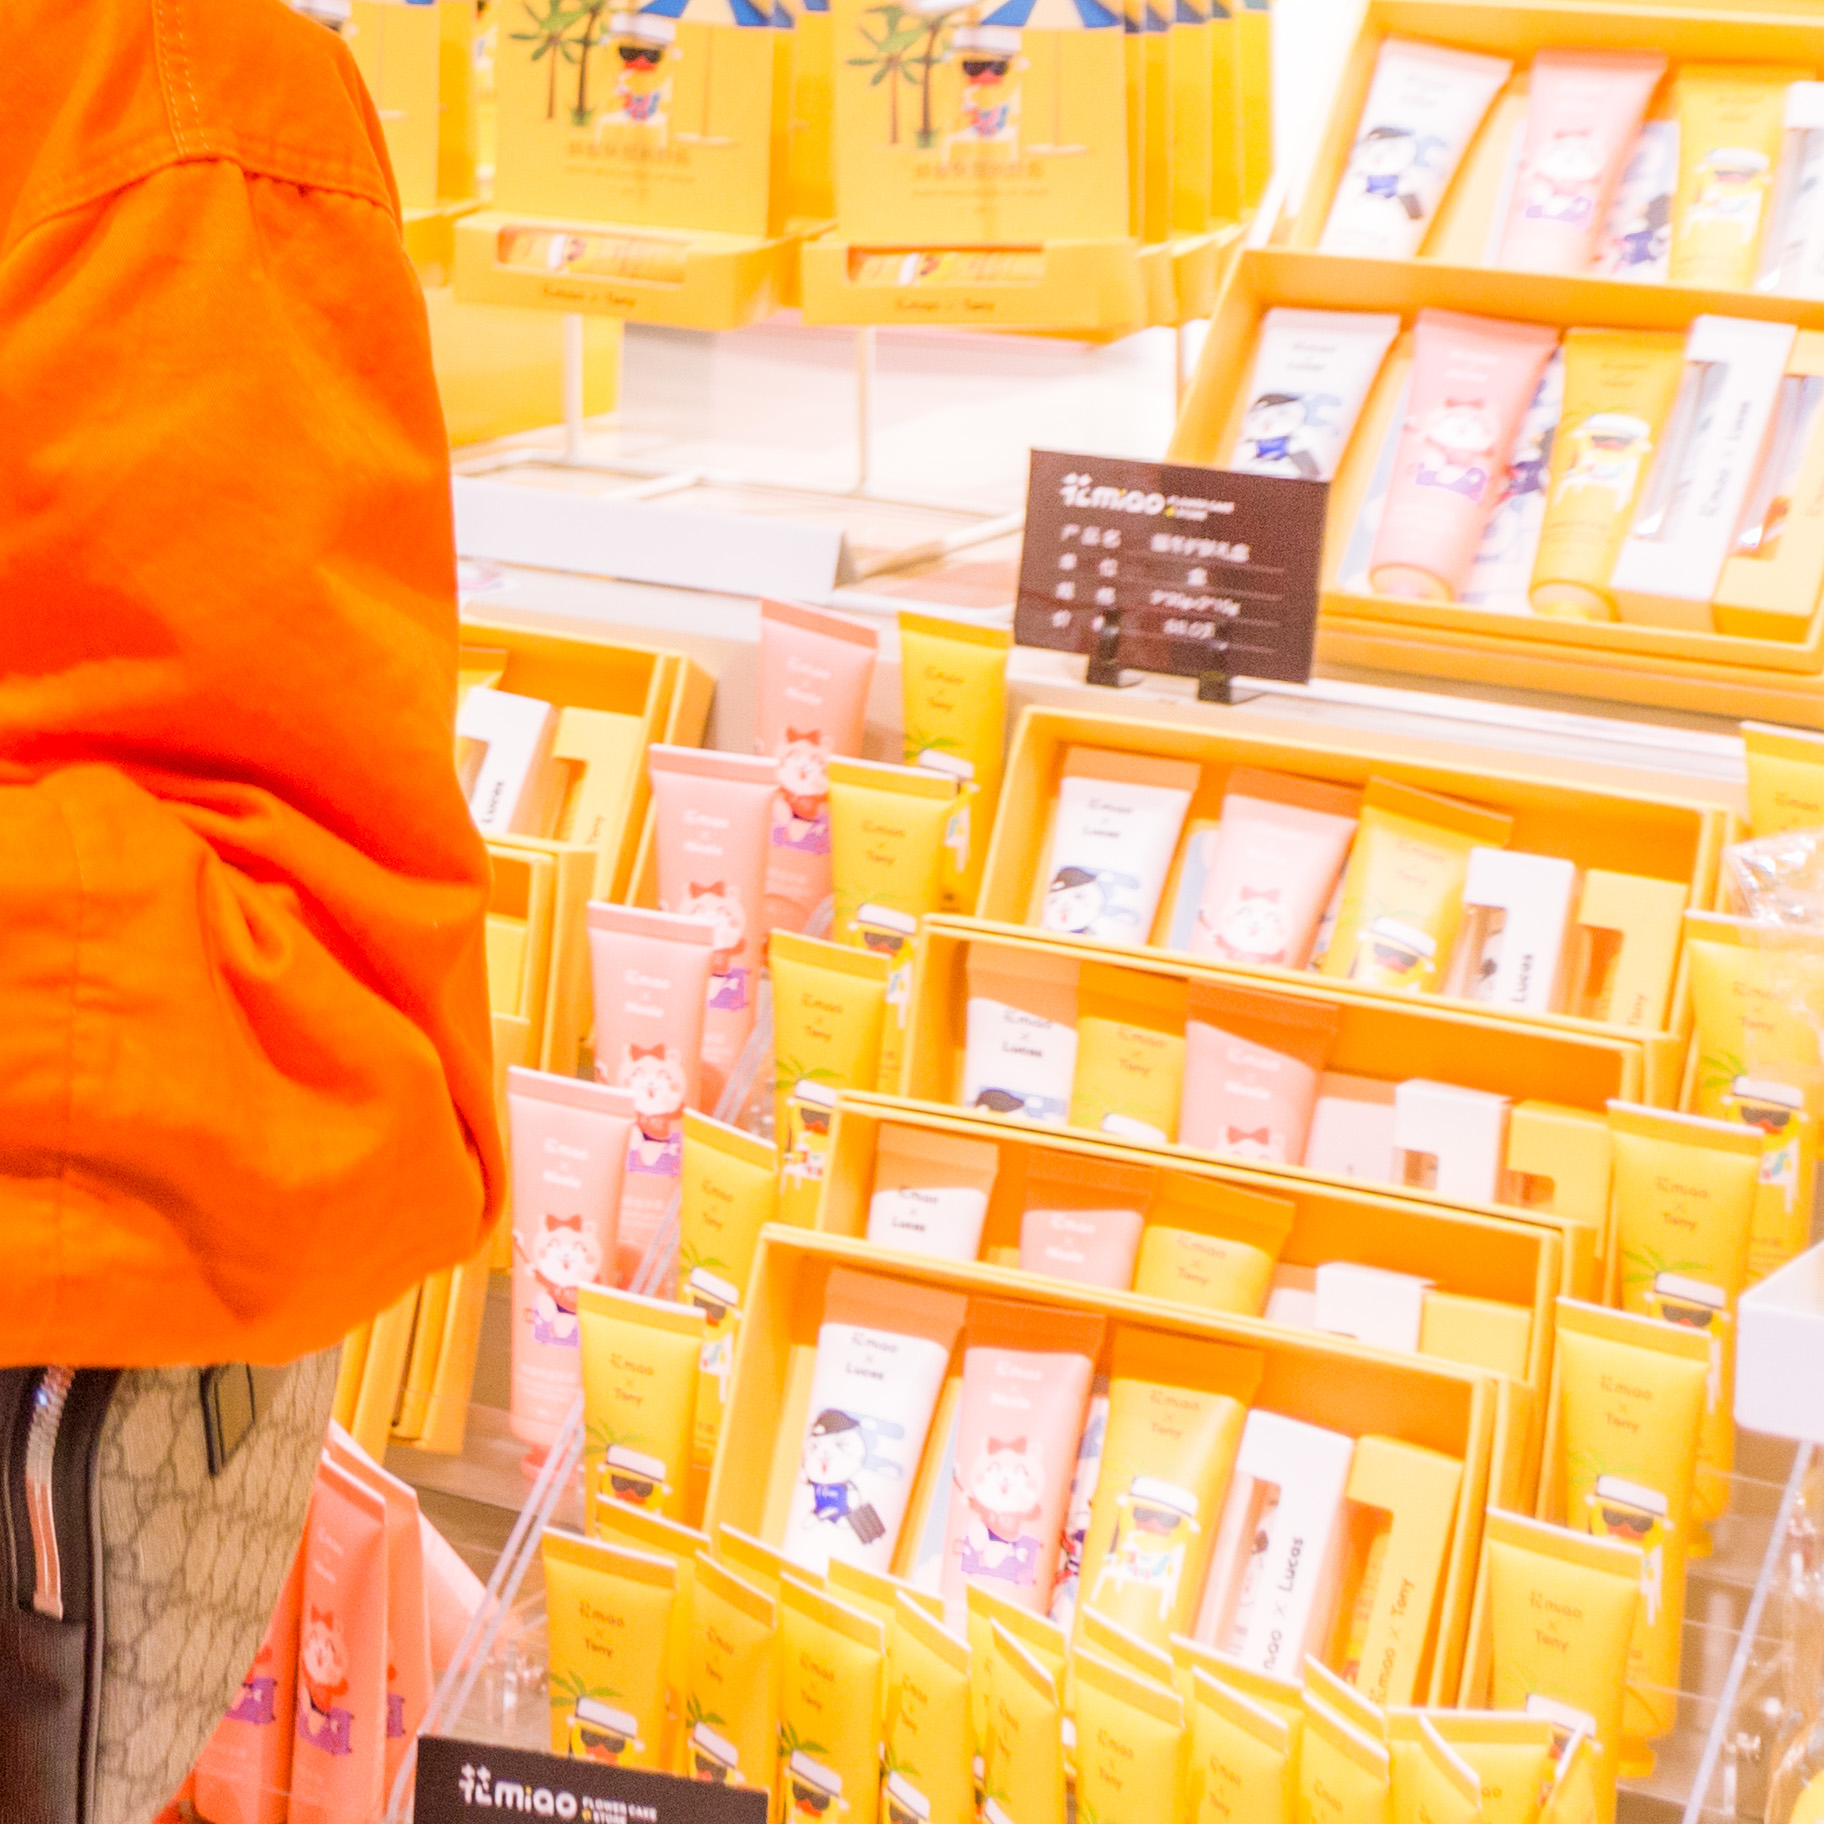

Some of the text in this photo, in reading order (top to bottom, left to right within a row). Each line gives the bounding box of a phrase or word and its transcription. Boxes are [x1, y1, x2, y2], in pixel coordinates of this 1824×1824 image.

[1277, 1536, 1305, 1593] Lucas
[1389, 1576, 1417, 1618] Tony
[458, 1762, 579, 1820] 花miao
